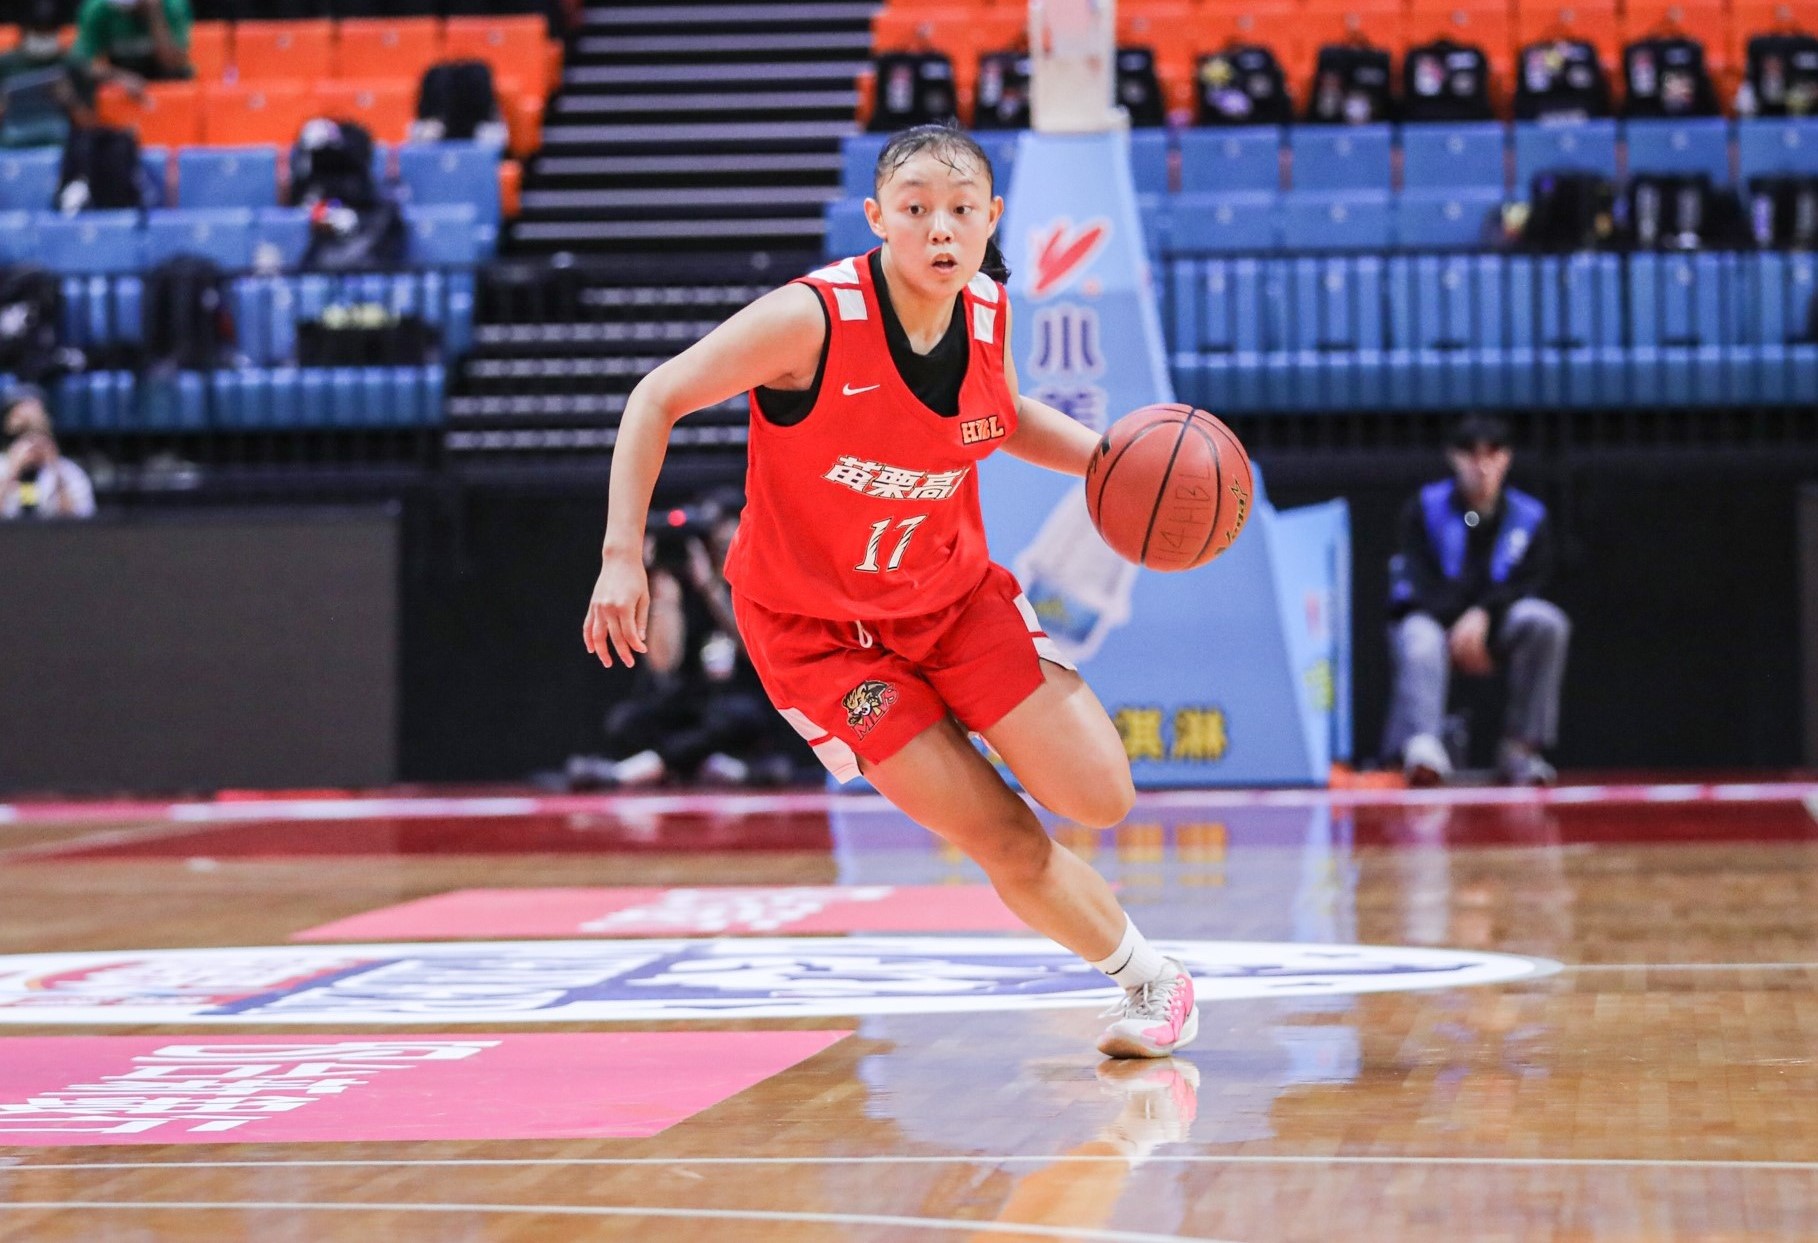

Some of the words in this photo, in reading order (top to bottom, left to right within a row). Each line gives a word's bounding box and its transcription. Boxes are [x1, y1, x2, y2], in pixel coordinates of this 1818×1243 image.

[960, 415, 1005, 445] HBL
[821, 455, 971, 500] 苗栗高
[853, 513, 929, 573] 17
